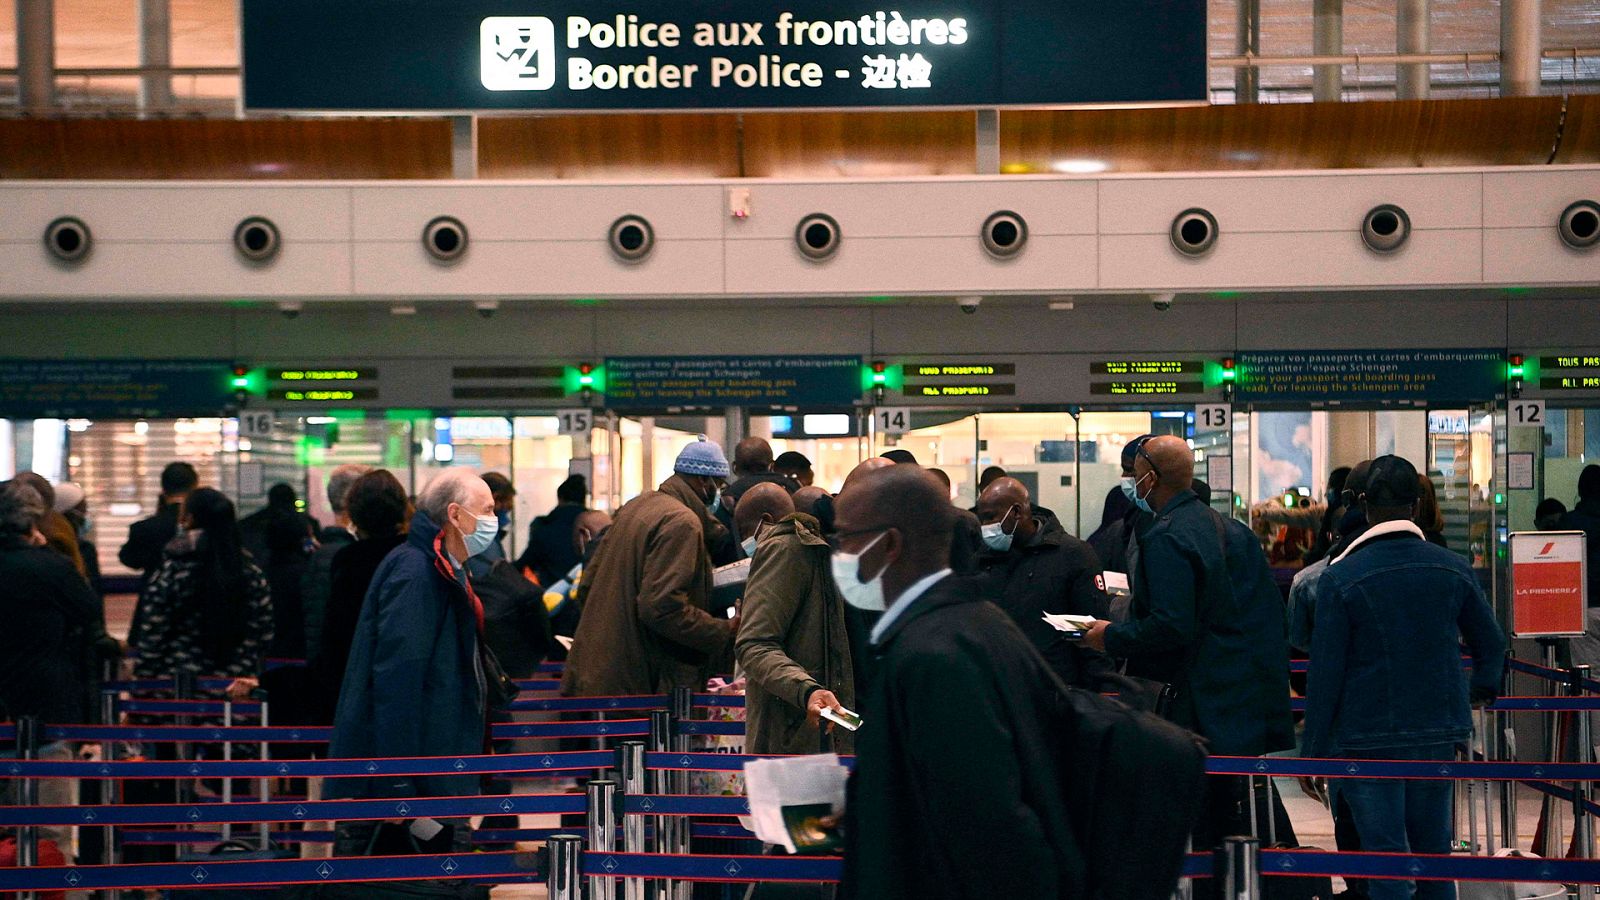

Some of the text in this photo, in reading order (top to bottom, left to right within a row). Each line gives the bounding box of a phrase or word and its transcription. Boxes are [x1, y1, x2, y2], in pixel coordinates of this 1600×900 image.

[567, 11, 968, 49] Police aux frontières
[567, 57, 699, 90] Border
[711, 54, 823, 88] Police
[862, 53, 932, 90] 边检
[1309, 354, 1363, 364] passeports
[1366, 353, 1376, 361] et
[1380, 353, 1410, 361] cartes
[1414, 352, 1500, 363] d'embarquement
[1557, 357, 1579, 367] TOUS
[1241, 364, 1265, 374] pour
[1268, 363, 1302, 374] quitter
[1350, 362, 1398, 373] Schengen
[1241, 372, 1436, 384] Have your passport and boarding pass
[1562, 377, 1578, 387] ALL
[1241, 383, 1268, 393] ready
[1273, 383, 1287, 391] for
[1291, 383, 1329, 393] leaving
[1332, 383, 1348, 391] the
[1351, 382, 1400, 393] Schengen
[563, 413, 587, 431] 15
[881, 411, 905, 429] 14
[1201, 408, 1226, 427] 13
[1514, 404, 1540, 423] 12
[246, 414, 270, 433] 16
